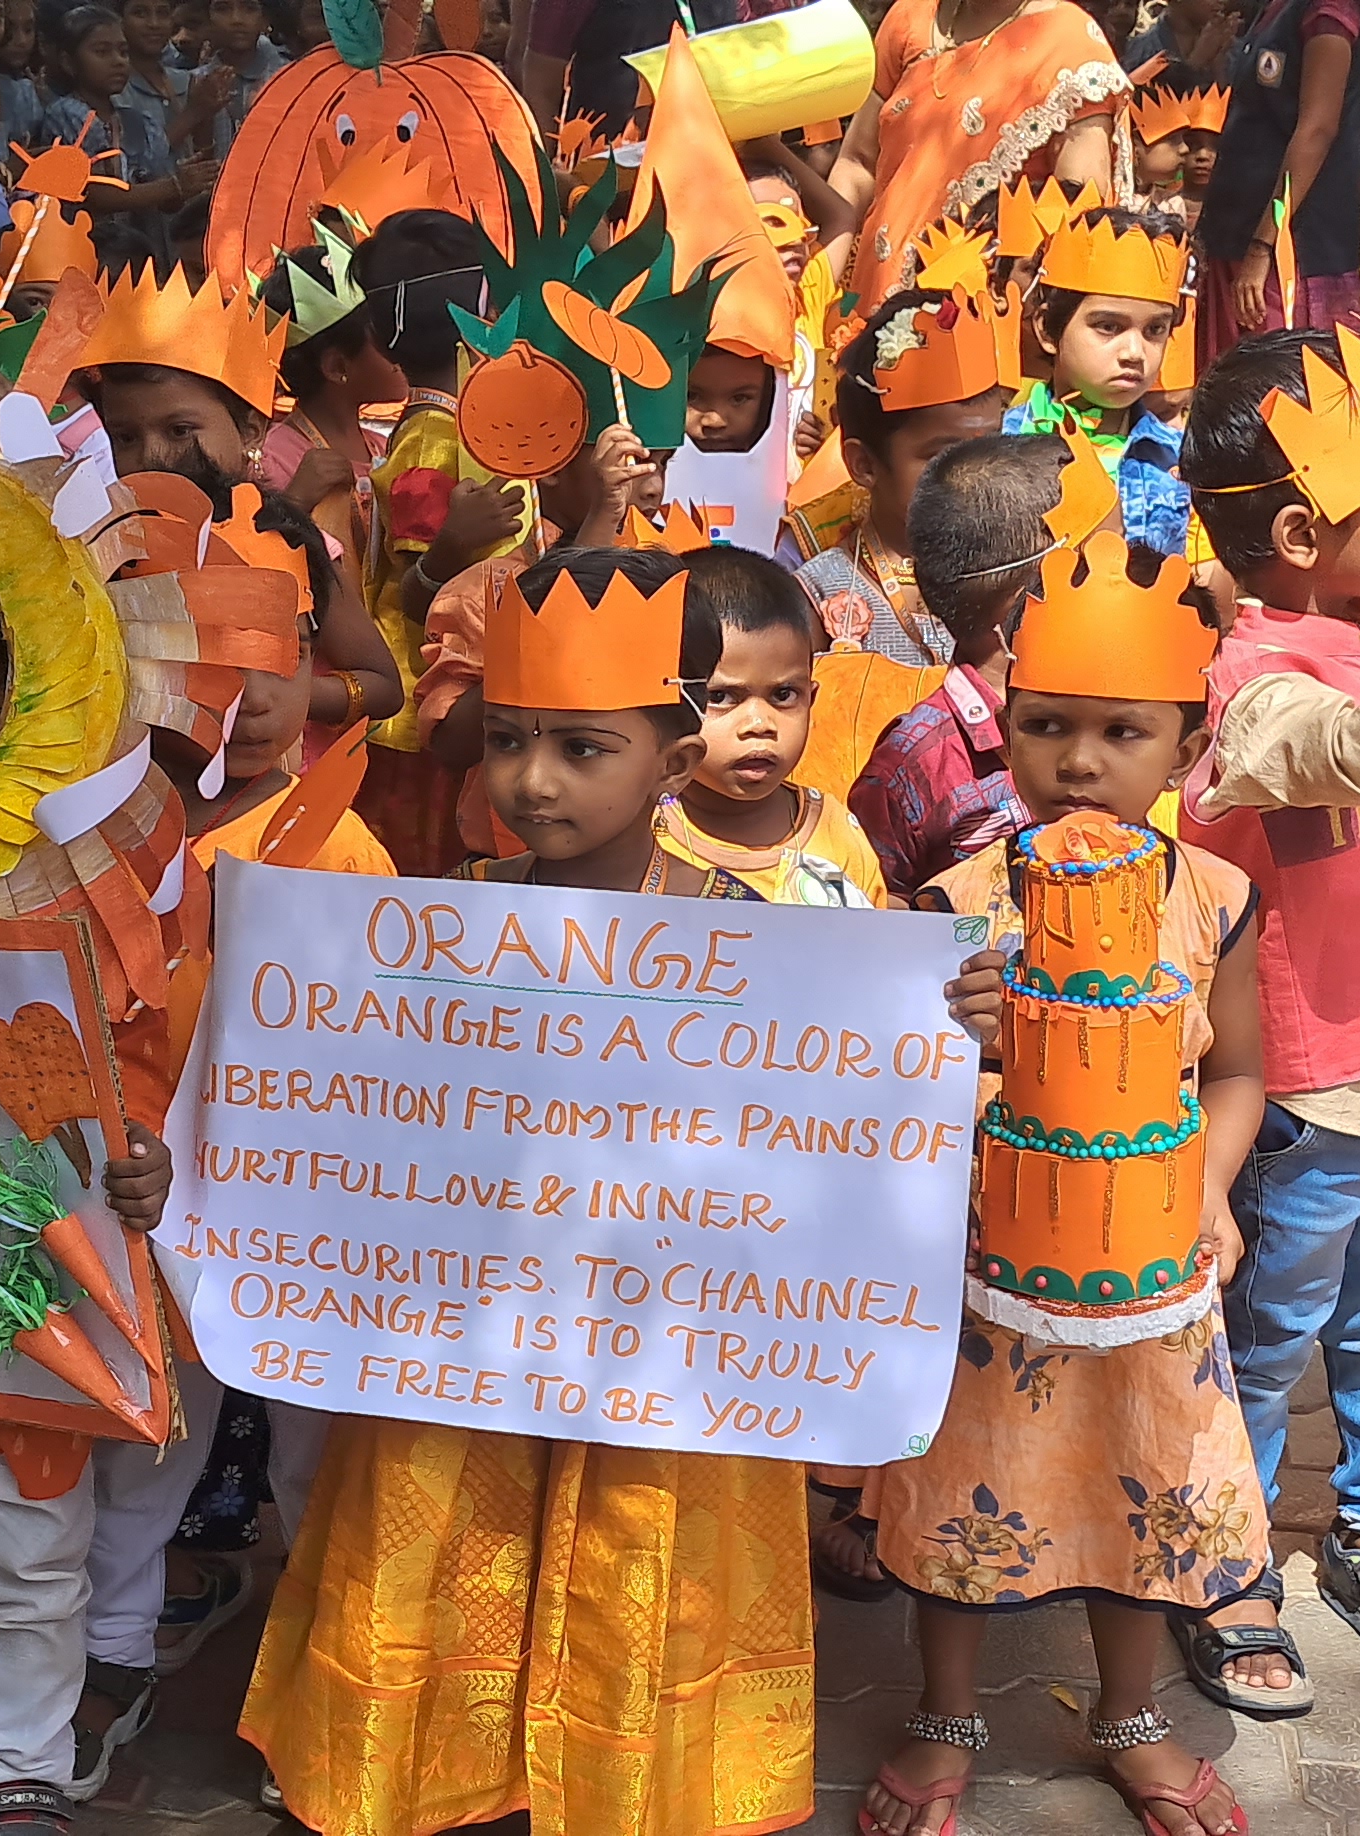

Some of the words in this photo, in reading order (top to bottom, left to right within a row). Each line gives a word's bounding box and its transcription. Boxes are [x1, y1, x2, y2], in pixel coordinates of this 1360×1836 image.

[367, 896, 754, 997] ORANGE
[251, 960, 521, 1051] ORANGE
[536, 1012, 584, 1057] IS
[601, 1013, 648, 1065] A
[667, 1010, 880, 1079] COLOR
[893, 1031, 966, 1081] OF
[200, 1062, 451, 1128] IBERATION
[463, 1086, 611, 1140] FROM
[618, 1101, 722, 1147] THE
[737, 1103, 881, 1158] PAINS
[889, 1117, 965, 1163] OF
[405, 1162, 527, 1211] LOVE
[532, 1173, 577, 1217] &
[588, 1179, 788, 1234] INNER
[174, 1212, 557, 1295] INSECURITIES.
[574, 1253, 651, 1305] TO
[250, 1340, 332, 1387] BE
[357, 1354, 508, 1405] FREE
[524, 1372, 588, 1415] TO
[600, 1387, 675, 1427] BE
[700, 1391, 817, 1442] YOU.
[512, 1314, 559, 1351] IS
[574, 1315, 641, 1358] TO
[666, 1324, 876, 1390] TRULY
